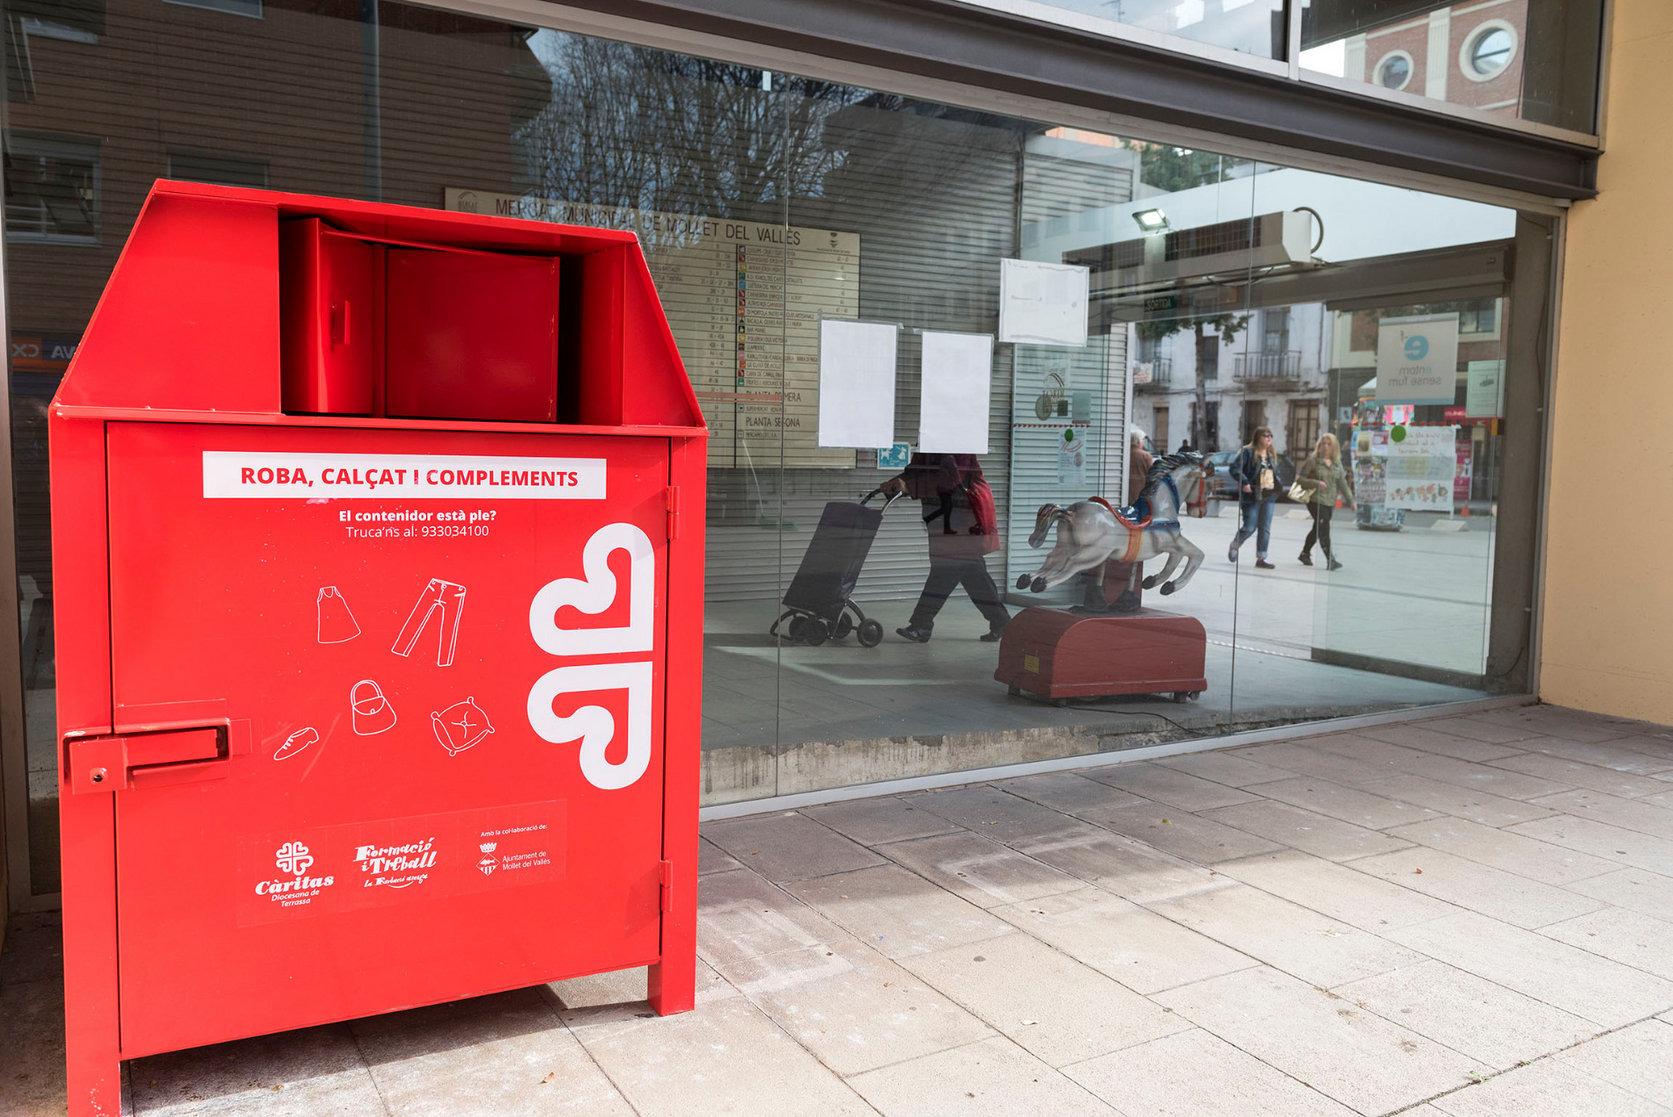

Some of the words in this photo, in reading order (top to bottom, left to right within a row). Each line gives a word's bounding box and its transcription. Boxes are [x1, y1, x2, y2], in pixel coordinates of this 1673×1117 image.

[667, 218, 719, 237] MOLLET
[726, 224, 750, 241] DEL
[745, 416, 772, 427] PLANTA
[240, 467, 314, 488] ROBA,
[321, 468, 407, 490] CALÇAT
[426, 469, 578, 487] COMPLEMENTS
[339, 510, 351, 522] El
[354, 509, 433, 522] contenidor
[436, 510, 466, 522] està
[469, 510, 497, 524] ple?
[403, 526, 418, 537] al:
[421, 525, 490, 538] 933034100
[480, 830, 495, 838] Amb
[353, 837, 435, 862] Formació
[502, 852, 538, 863] Ajuntament
[538, 850, 547, 858] de
[369, 851, 438, 875] Treball
[502, 861, 522, 871] Mollet
[522, 859, 533, 868] del
[255, 876, 335, 895] Càritas
[271, 890, 310, 902] Diocesana
[310, 888, 320, 897] de
[281, 897, 311, 907] Terrassa
